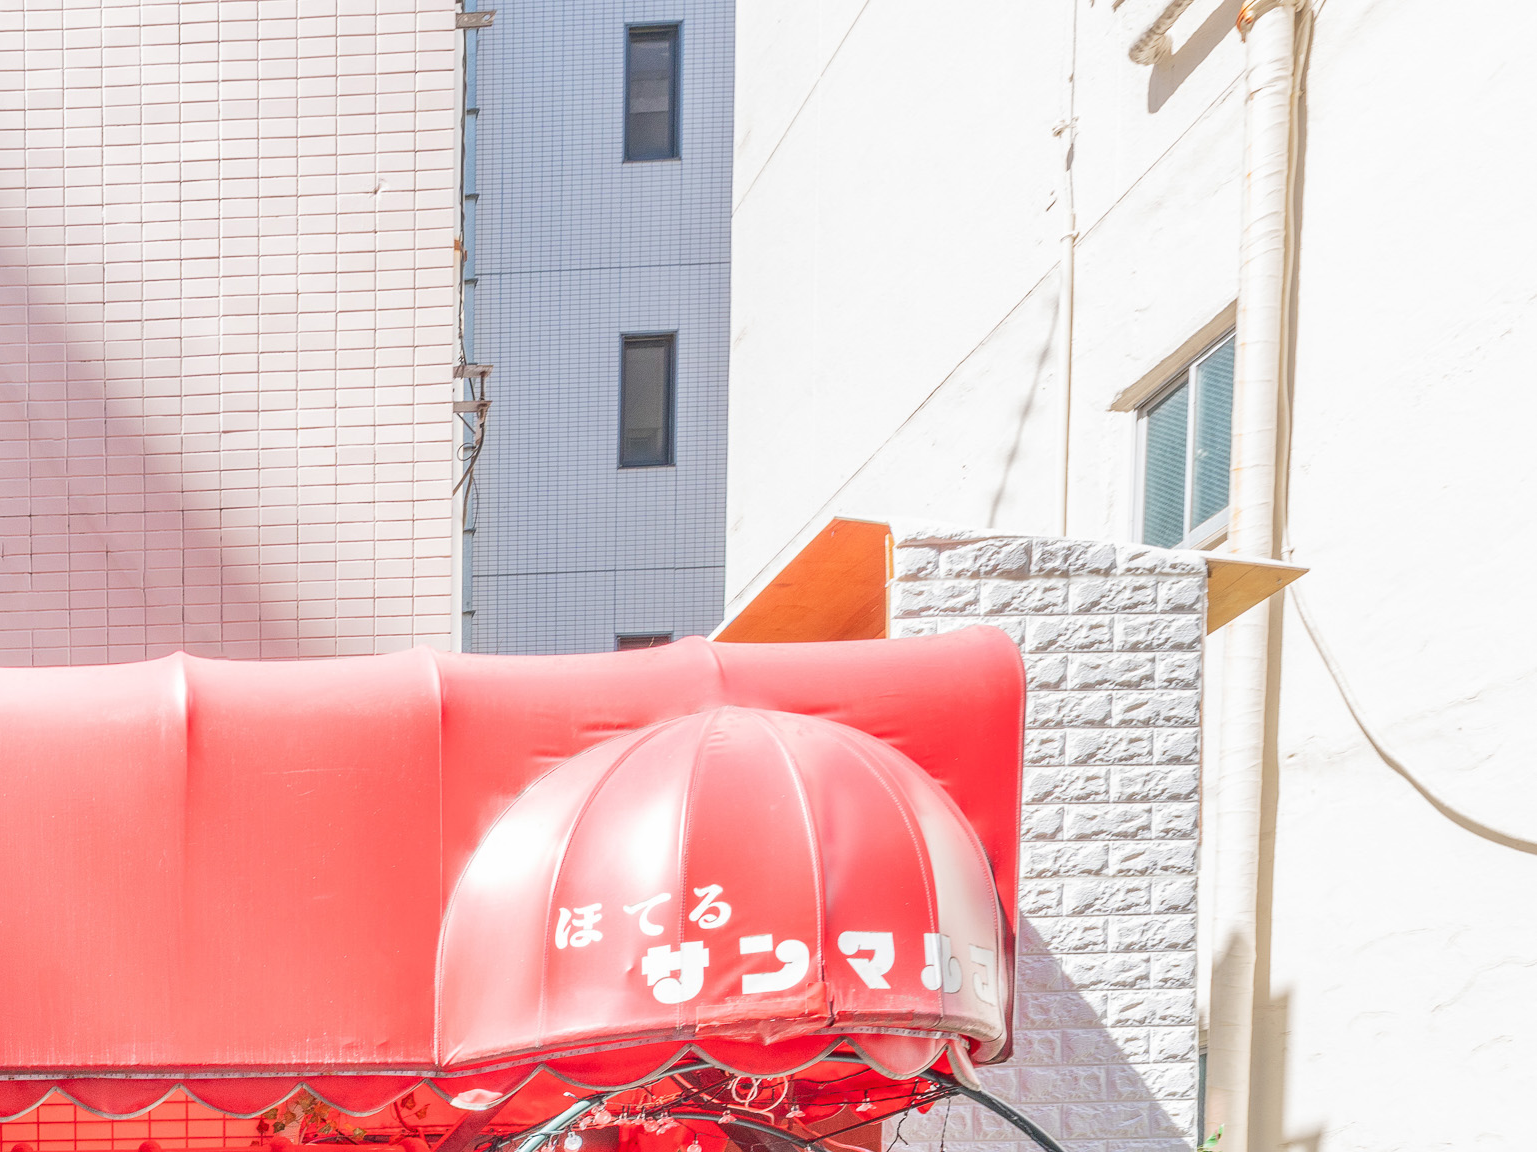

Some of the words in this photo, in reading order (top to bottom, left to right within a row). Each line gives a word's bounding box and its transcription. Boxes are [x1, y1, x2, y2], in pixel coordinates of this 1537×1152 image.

[555, 884, 732, 949] ほてる
[642, 931, 997, 1007] サンマルコ
